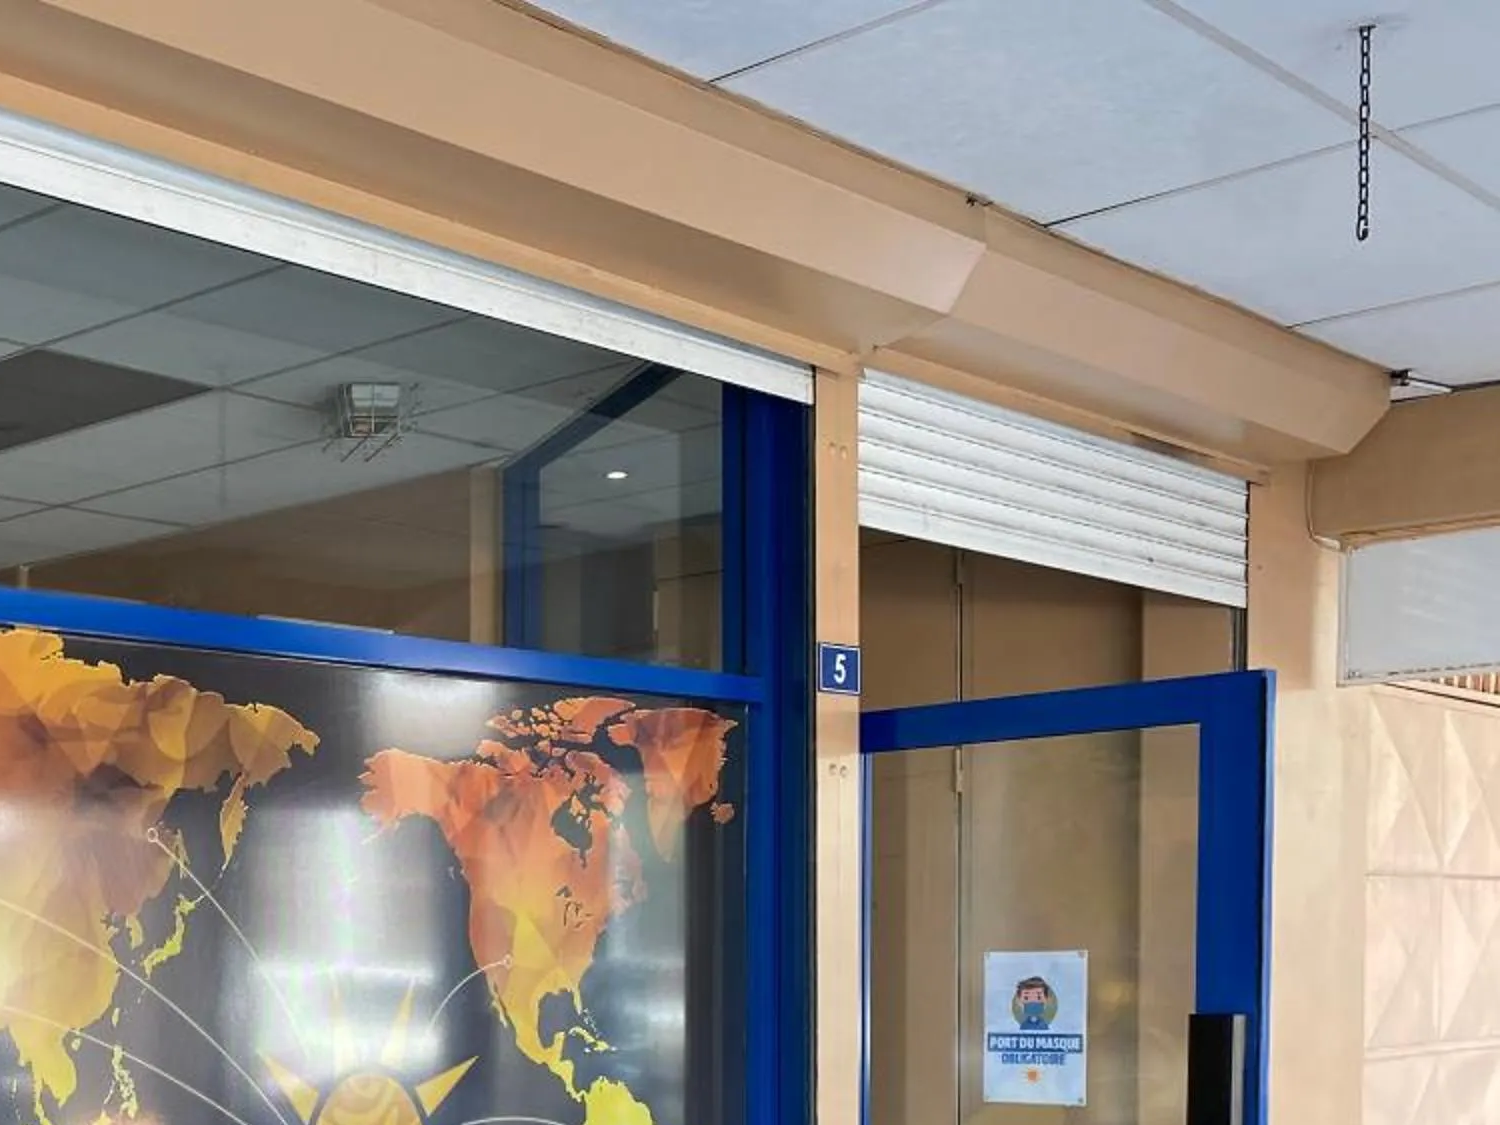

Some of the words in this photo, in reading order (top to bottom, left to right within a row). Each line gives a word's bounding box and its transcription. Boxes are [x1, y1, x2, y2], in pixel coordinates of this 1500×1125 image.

[833, 653, 847, 685] 5
[989, 1036, 1017, 1049] PORT
[1019, 1036, 1034, 1049] DU
[1036, 1037, 1080, 1052] MASQUE
